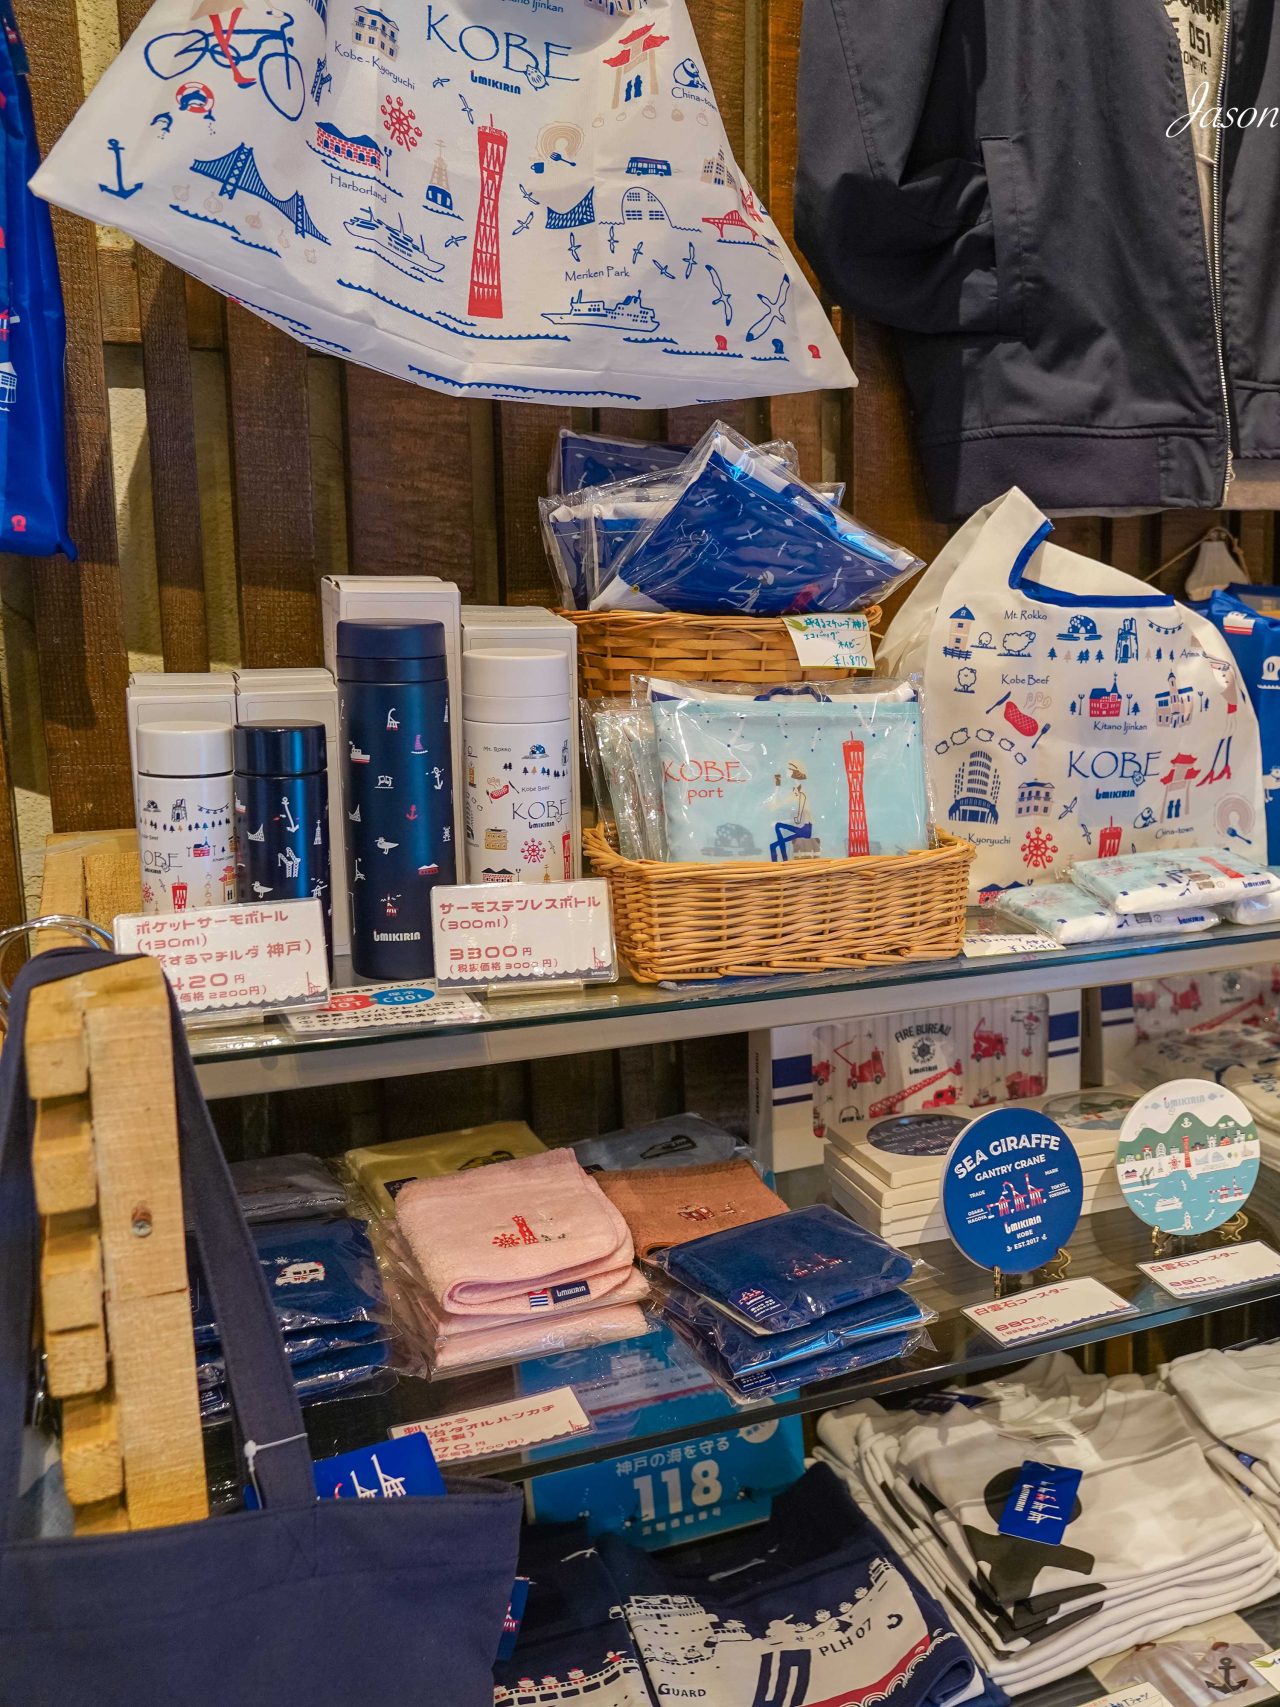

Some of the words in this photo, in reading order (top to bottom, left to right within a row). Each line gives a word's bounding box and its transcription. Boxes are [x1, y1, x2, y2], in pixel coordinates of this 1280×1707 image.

[426, 5, 580, 82] KOBE
[330, 173, 388, 204] Harborland
[565, 268, 605, 283] Meriken
[607, 266, 630, 279] Park
[1020, 610, 1048, 621] Rokko
[1001, 674, 1026, 686] Kobe
[1027, 674, 1050, 685] Beef
[1093, 721, 1122, 732] Kitano
[663, 759, 748, 783] KOBE
[1067, 750, 1162, 779] KOBE
[687, 787, 724, 806] port
[512, 798, 569, 820] KOBE
[143, 850, 183, 868] OBE
[440, 896, 600, 915] サーモステンレスボトル
[136, 910, 289, 936] ポケットサーモボトル
[440, 915, 508, 932] (300ml)
[137, 933, 208, 953] (130ml)
[383, 995, 427, 1003] COOL
[895, 1026, 914, 1043] FIRE
[916, 1023, 951, 1036] BUREAU
[954, 1148, 989, 1180] SEA
[989, 1133, 1061, 1157] GIRAFFE
[974, 1163, 1012, 1182] GANTRY
[1014, 1154, 1046, 1173] CRANE
[969, 1190, 986, 1199] TRADE
[1016, 1229, 1034, 1239] KOBE
[428, 1403, 556, 1439] 治タオルハンカチ
[616, 1437, 730, 1477] 神戸の海を守る
[633, 1459, 723, 1522] 118
[818, 1637, 854, 1658] PLH
[855, 1617, 872, 1639] 07
